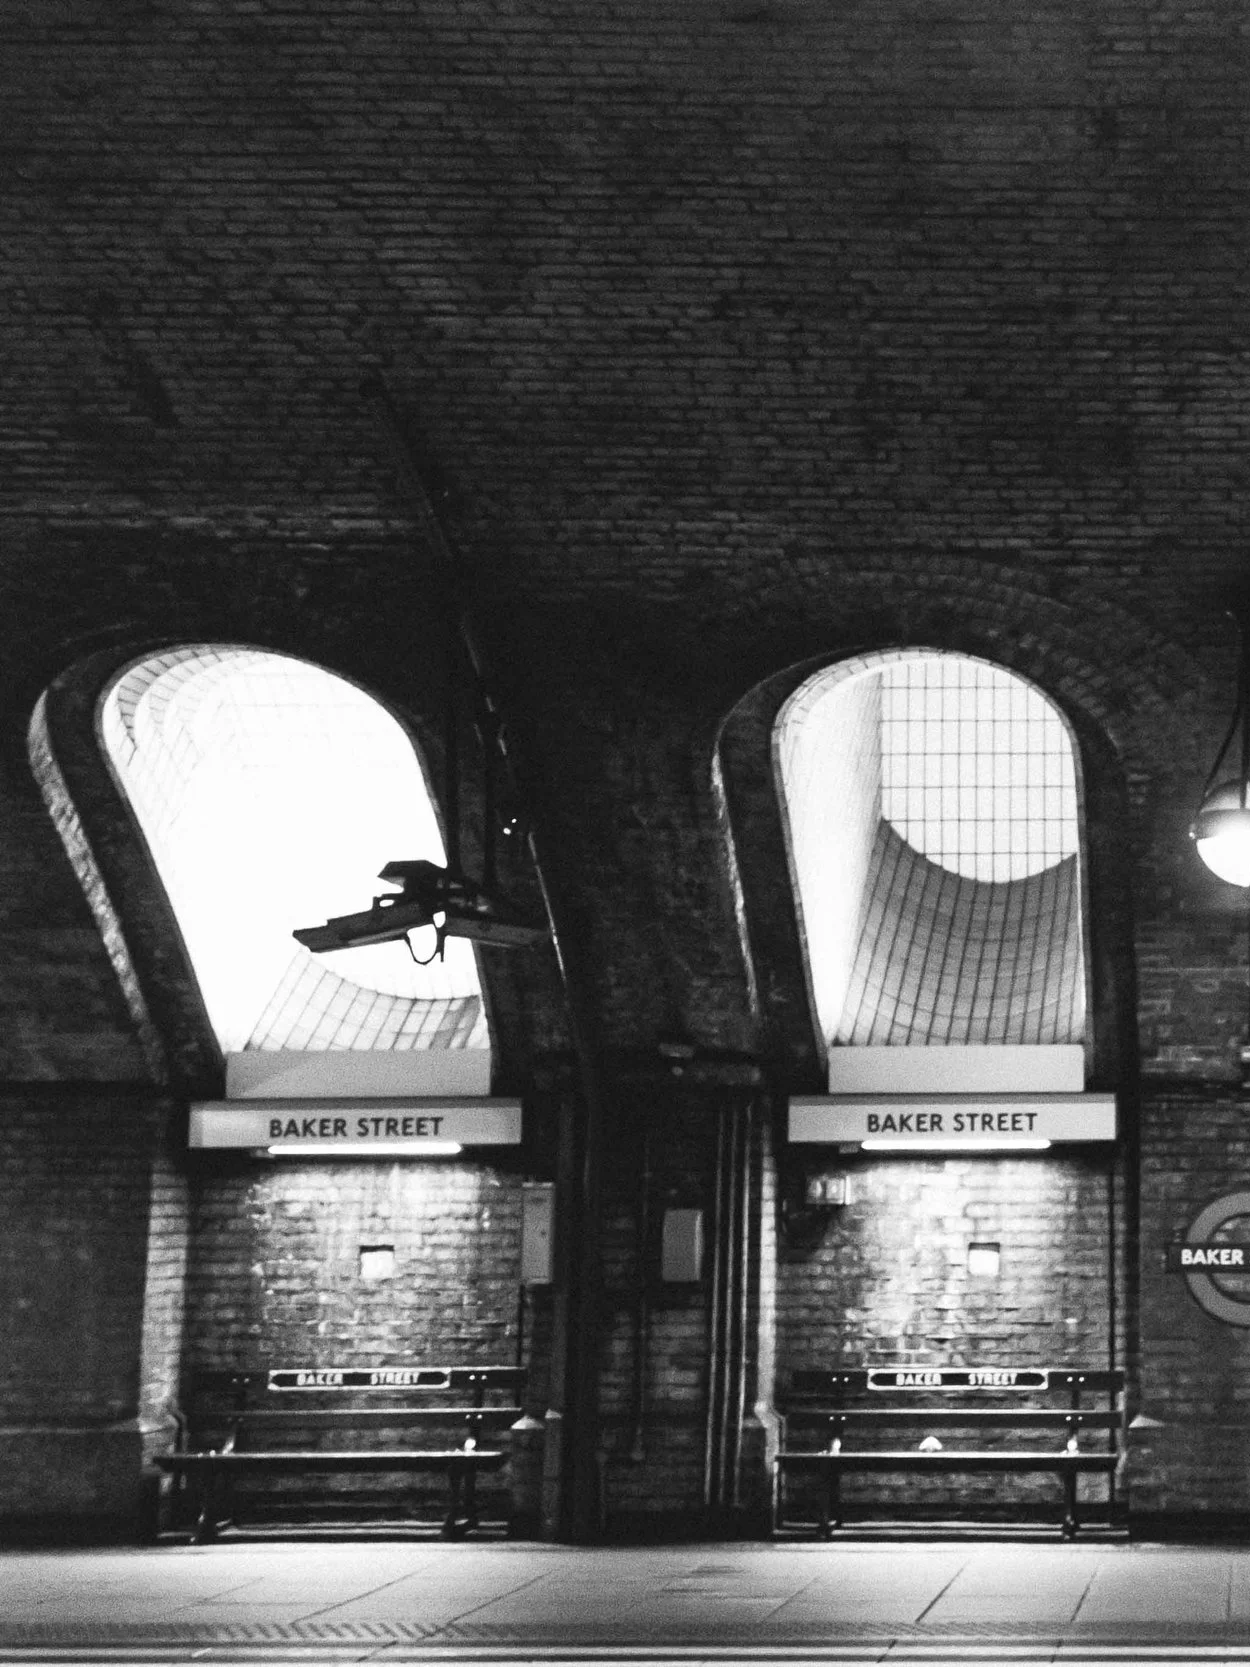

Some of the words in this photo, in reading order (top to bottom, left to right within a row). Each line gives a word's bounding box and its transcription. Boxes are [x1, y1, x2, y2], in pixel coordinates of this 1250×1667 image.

[269, 1117, 347, 1138] BAKER
[356, 1116, 445, 1137] STREET
[867, 1112, 943, 1133] BAKER
[953, 1112, 1038, 1132] STREET
[1181, 1248, 1244, 1265] BAKER
[296, 1372, 343, 1386] BAKER
[370, 1371, 420, 1385] STREET
[895, 1372, 942, 1386] BAKER
[968, 1372, 1018, 1386] STREET
